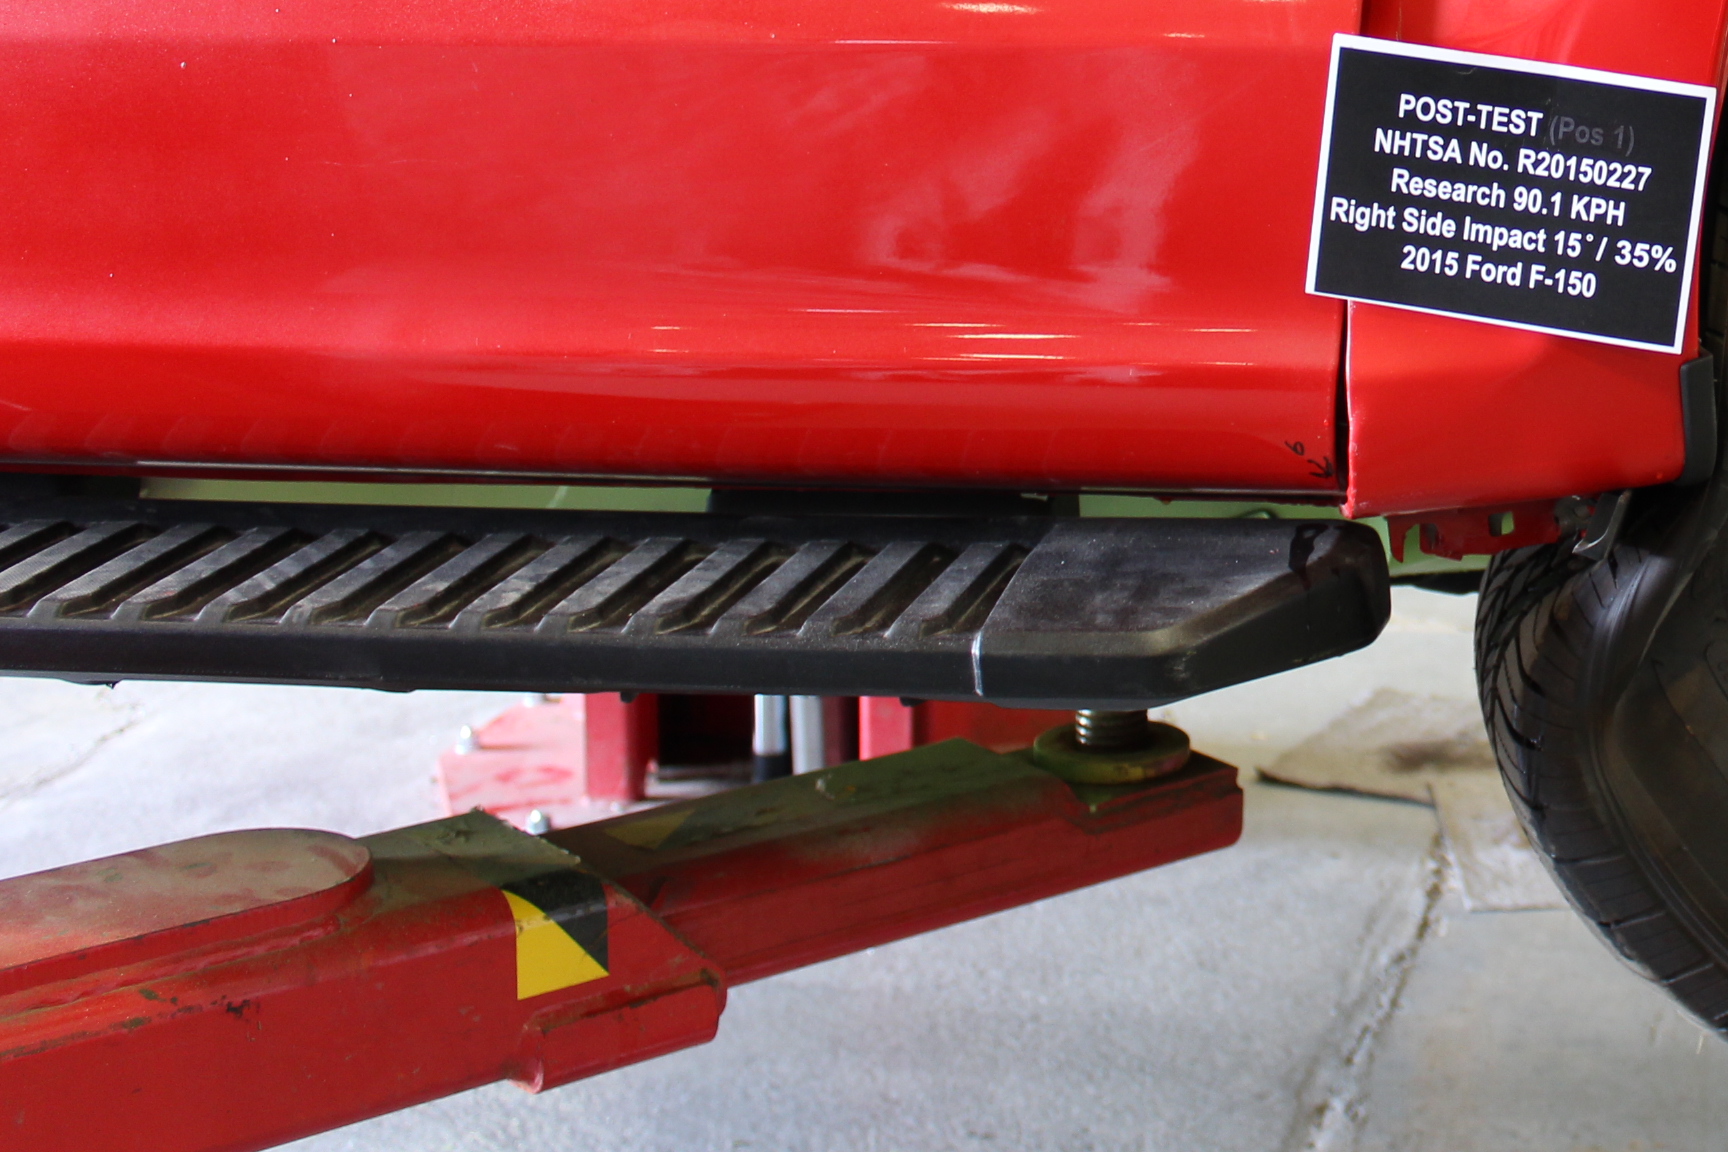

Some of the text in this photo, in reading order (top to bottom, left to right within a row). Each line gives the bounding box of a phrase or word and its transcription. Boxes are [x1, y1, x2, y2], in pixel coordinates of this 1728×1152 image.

[1398, 93, 1635, 157] POST-TEST (Pos 1)
[1373, 127, 1653, 192] NHTSA No. R20150227
[1391, 167, 1626, 227] Research 90.1 KPH
[1330, 196, 1397, 232] Right
[1401, 206, 1457, 239] Side
[1462, 215, 1547, 251] Impact
[1614, 239, 1677, 274] 35%
[1400, 244, 1597, 299] 2015 Ford F-150
